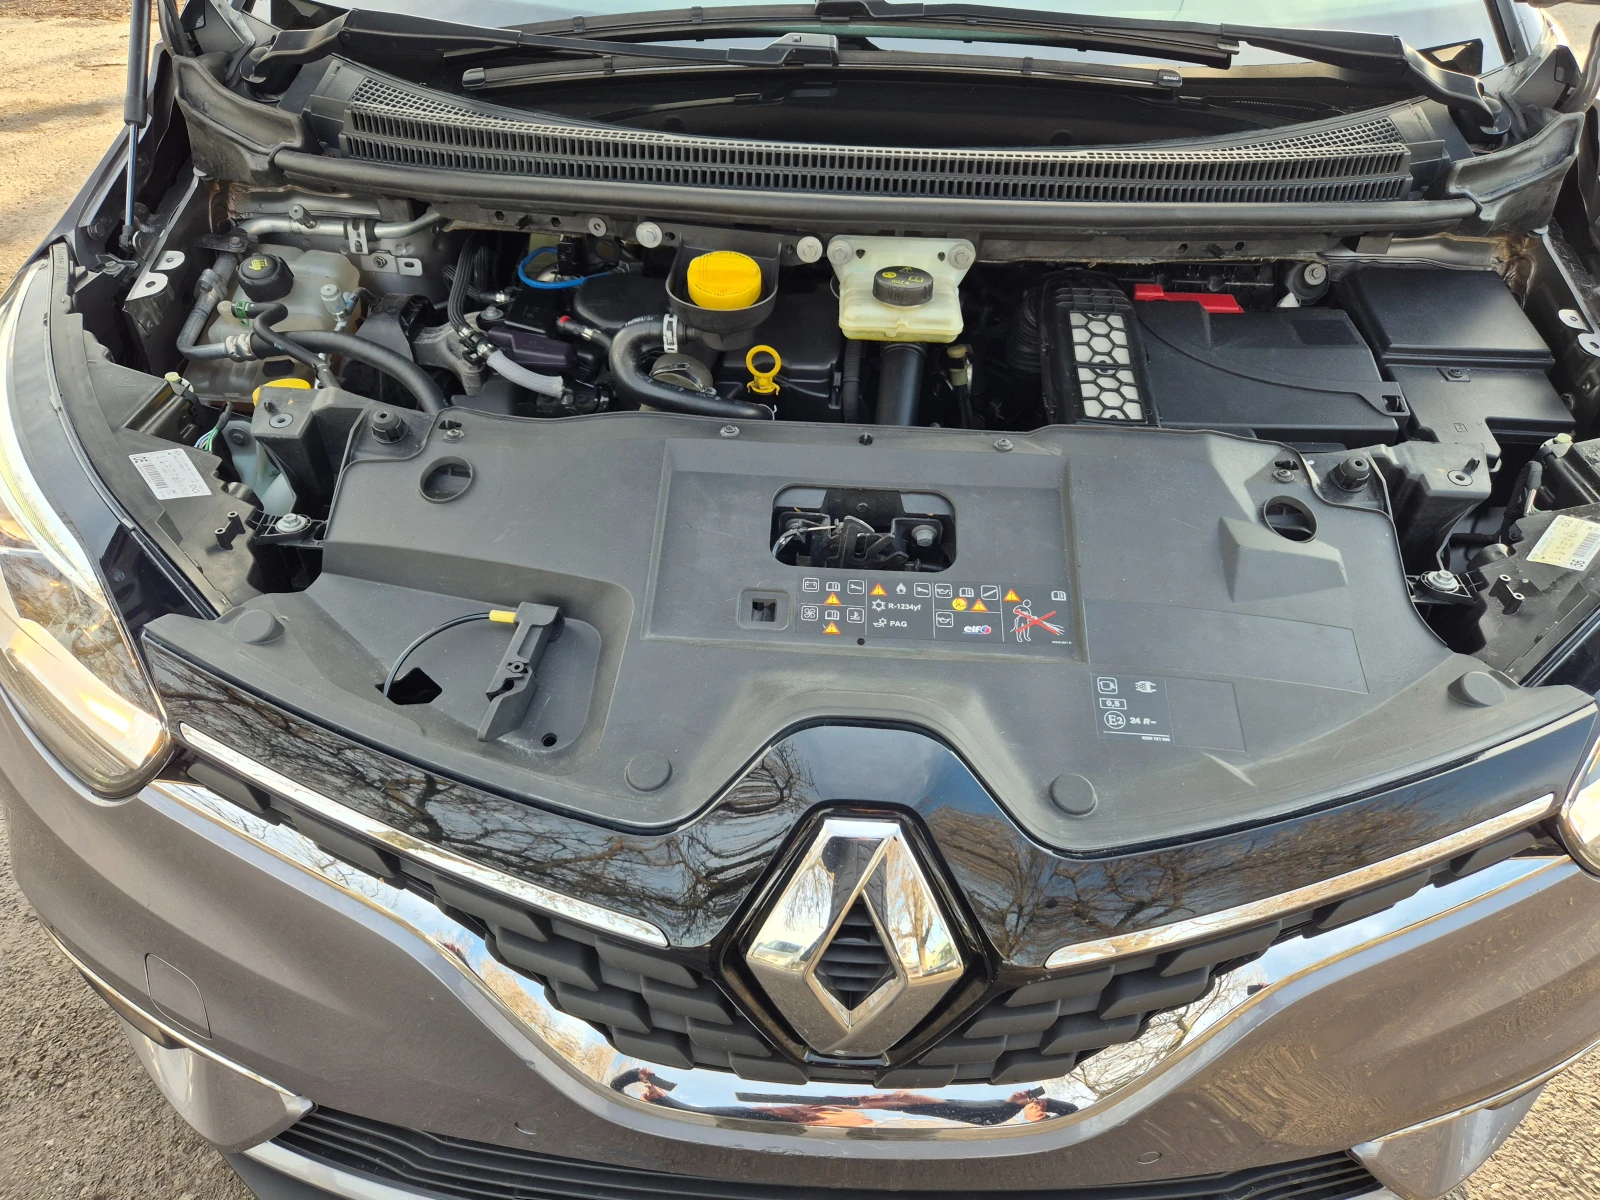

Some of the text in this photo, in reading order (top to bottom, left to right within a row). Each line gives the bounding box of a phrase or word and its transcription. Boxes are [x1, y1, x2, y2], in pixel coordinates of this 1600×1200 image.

[888, 602, 921, 612] R-1234yf
[889, 620, 908, 628] PAG
[1107, 714, 1124, 726] E2
[1130, 717, 1141, 725] 24
